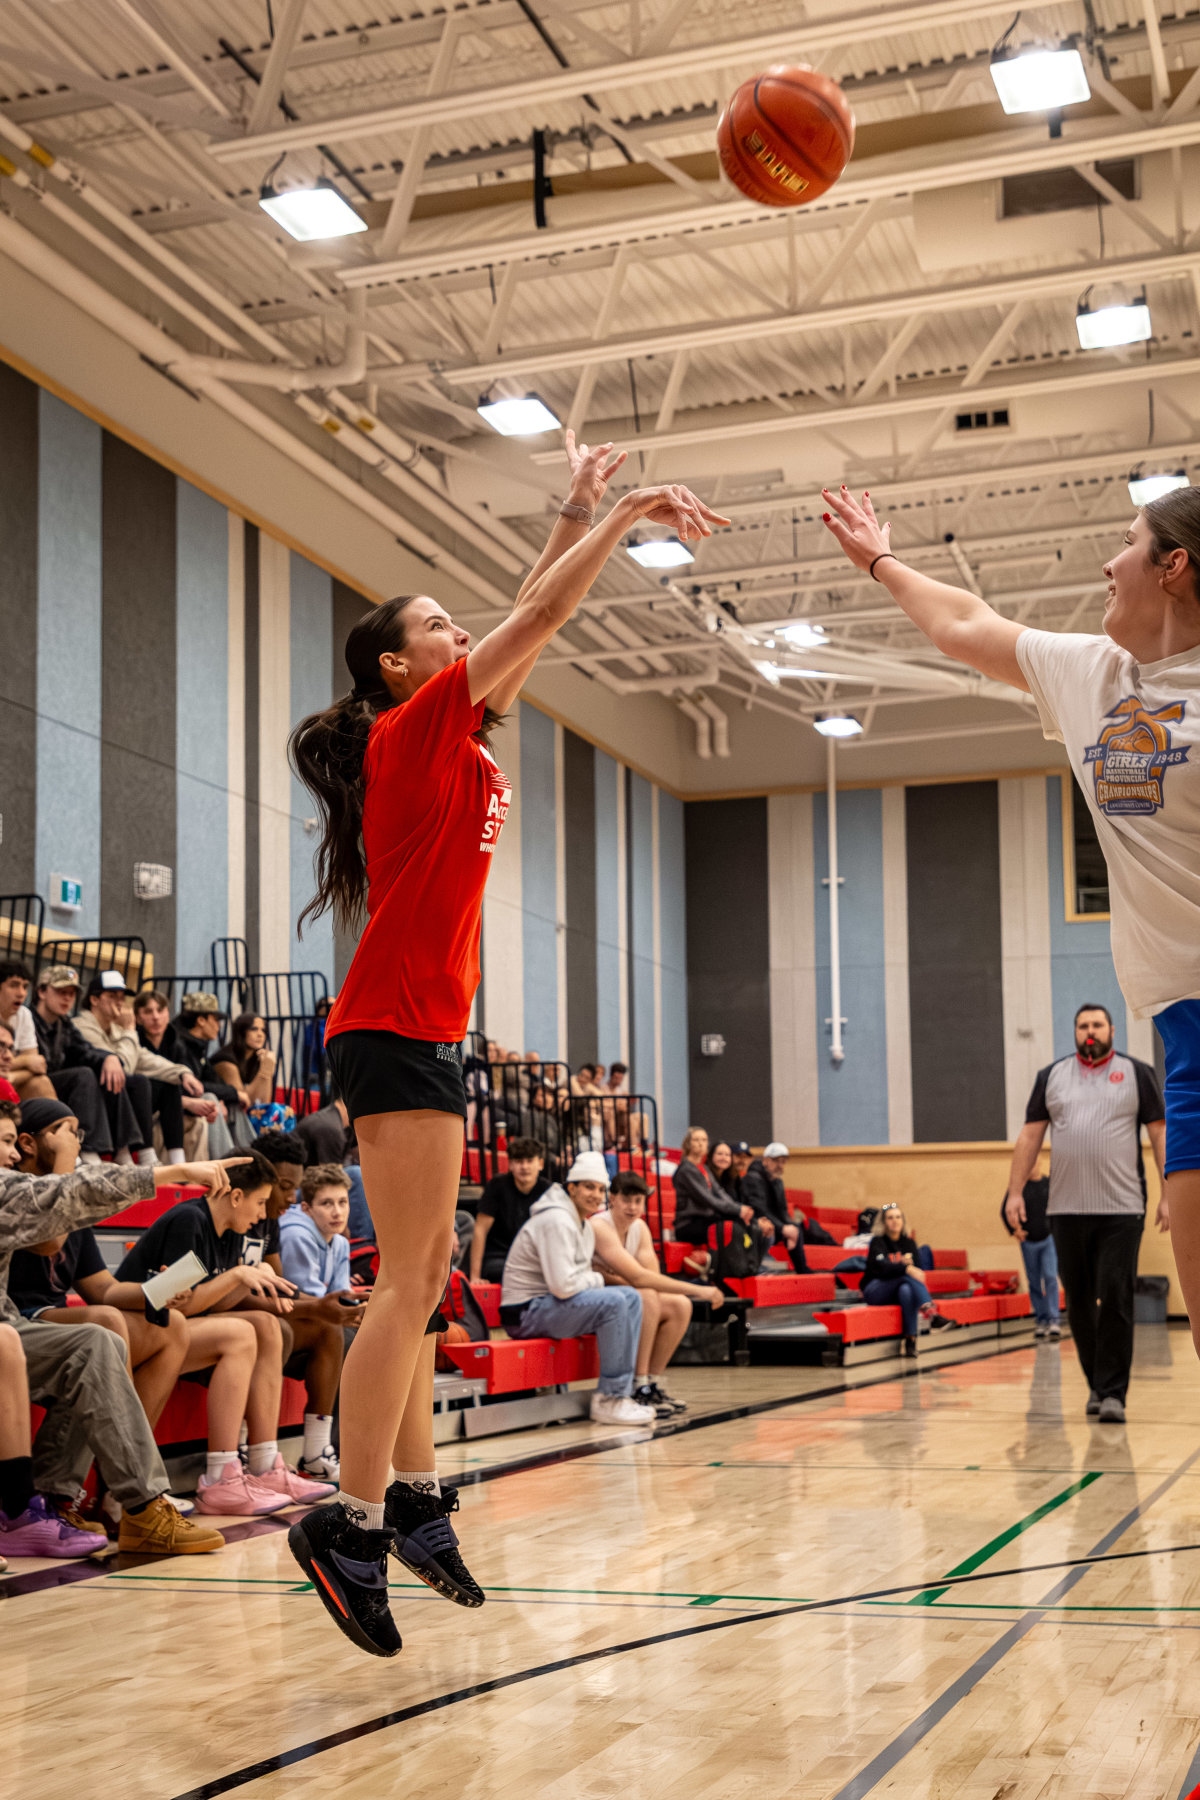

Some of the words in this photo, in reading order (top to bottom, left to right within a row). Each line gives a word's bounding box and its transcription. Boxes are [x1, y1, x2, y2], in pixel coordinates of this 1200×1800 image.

[1088, 748, 1103, 759] EST.
[1156, 752, 1182, 764] 1948
[1106, 757, 1148, 768] GIRLS
[1106, 775, 1146, 783] PROVINCIAL
[1100, 784, 1158, 801] CHAMPIONSHIPS
